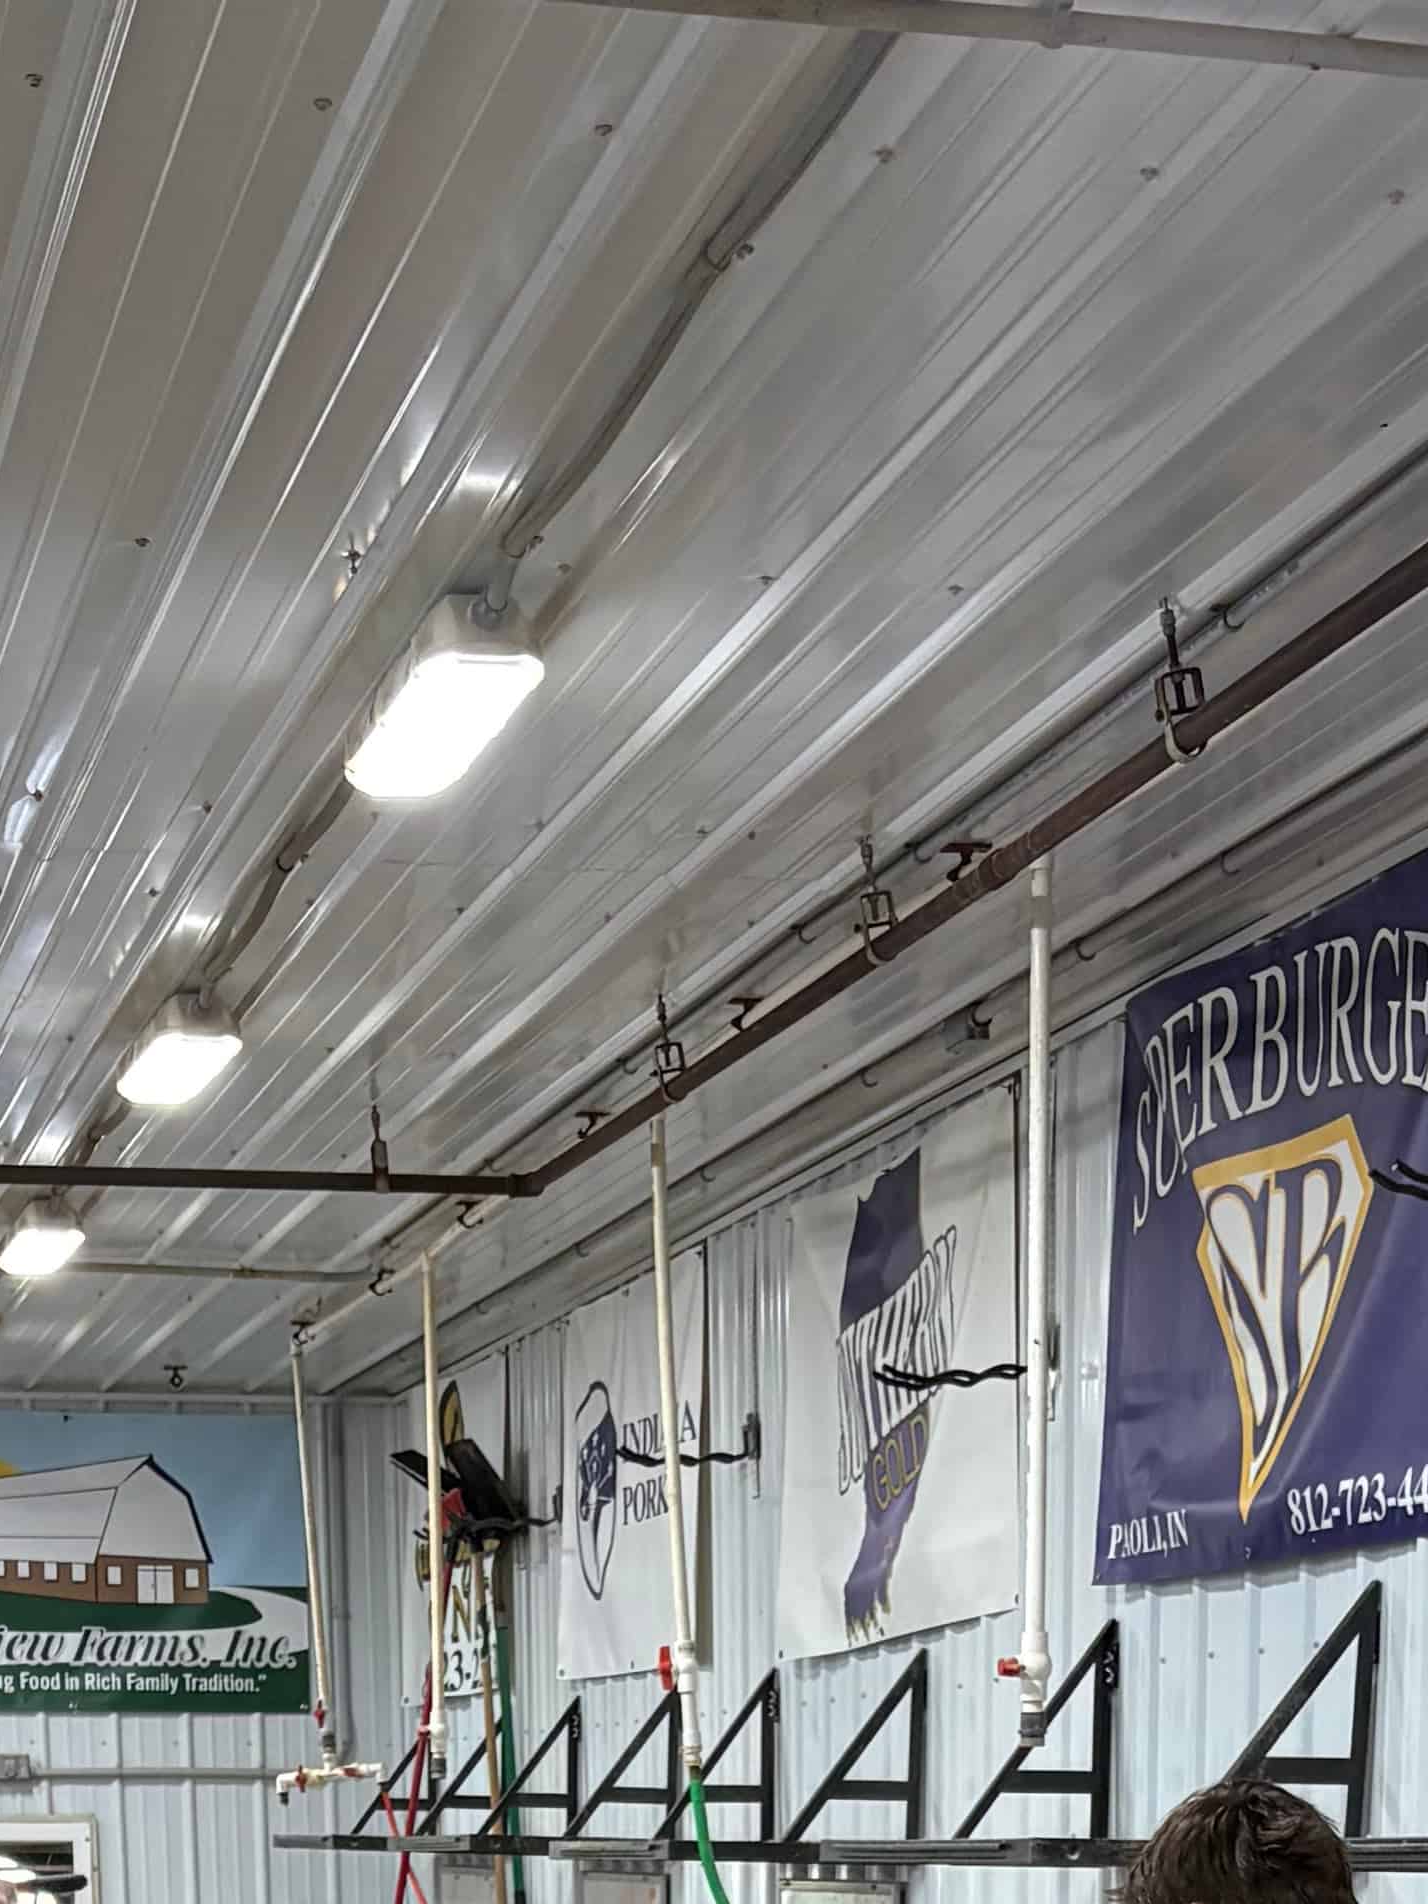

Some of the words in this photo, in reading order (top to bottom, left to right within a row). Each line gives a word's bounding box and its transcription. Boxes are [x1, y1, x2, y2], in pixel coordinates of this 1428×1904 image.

[871, 1414, 929, 1512] GOLD
[221, 1629, 298, 1668] Inc.
[19, 1671, 61, 1691] Food
[64, 1671, 80, 1691] in
[84, 1673, 122, 1692] Rich
[126, 1673, 179, 1695] Family
